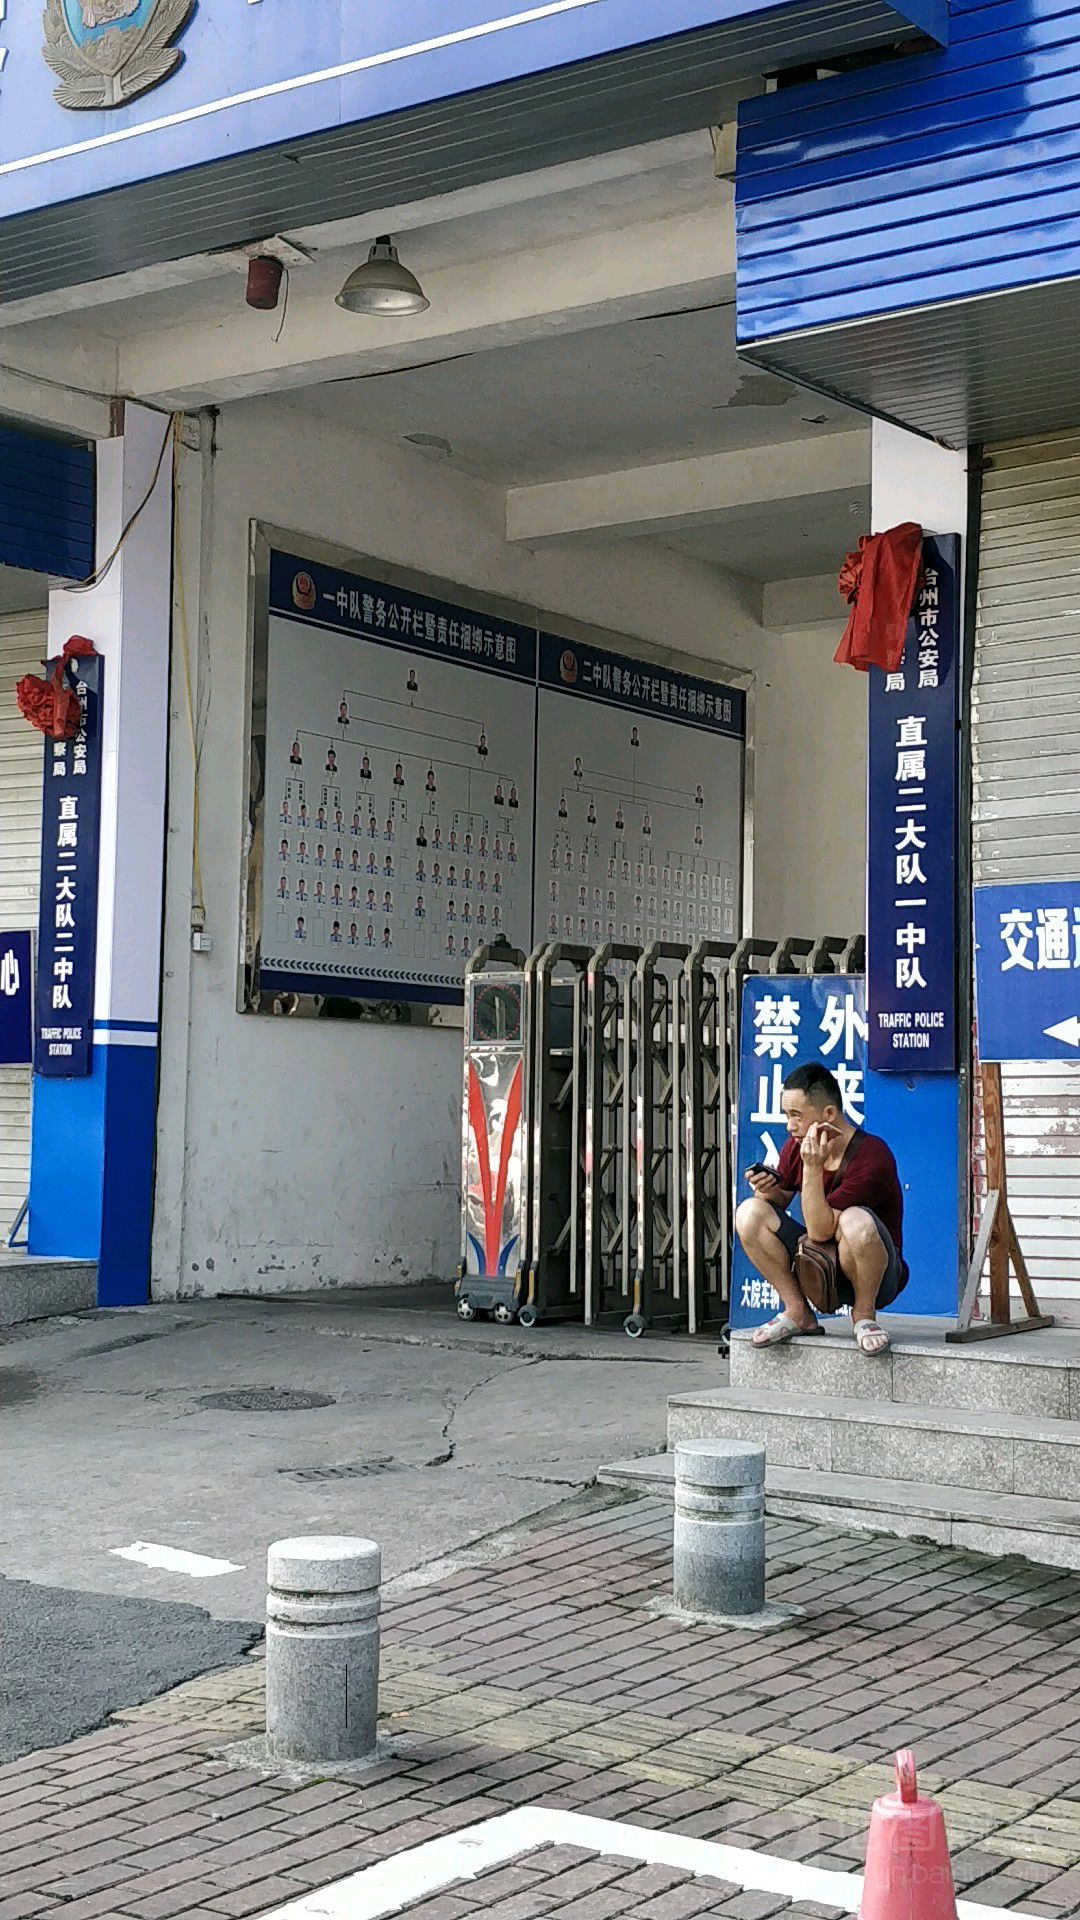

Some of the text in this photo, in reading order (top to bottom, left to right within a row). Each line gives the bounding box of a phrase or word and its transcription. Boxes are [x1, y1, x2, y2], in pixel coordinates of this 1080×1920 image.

[51, 795, 80, 1010] 直属二大队二中队
[893, 715, 929, 989] 直属二大队一中队
[878, 1011, 945, 1028] TRAFFIC POLICE
[892, 1032, 930, 1049] STATION
